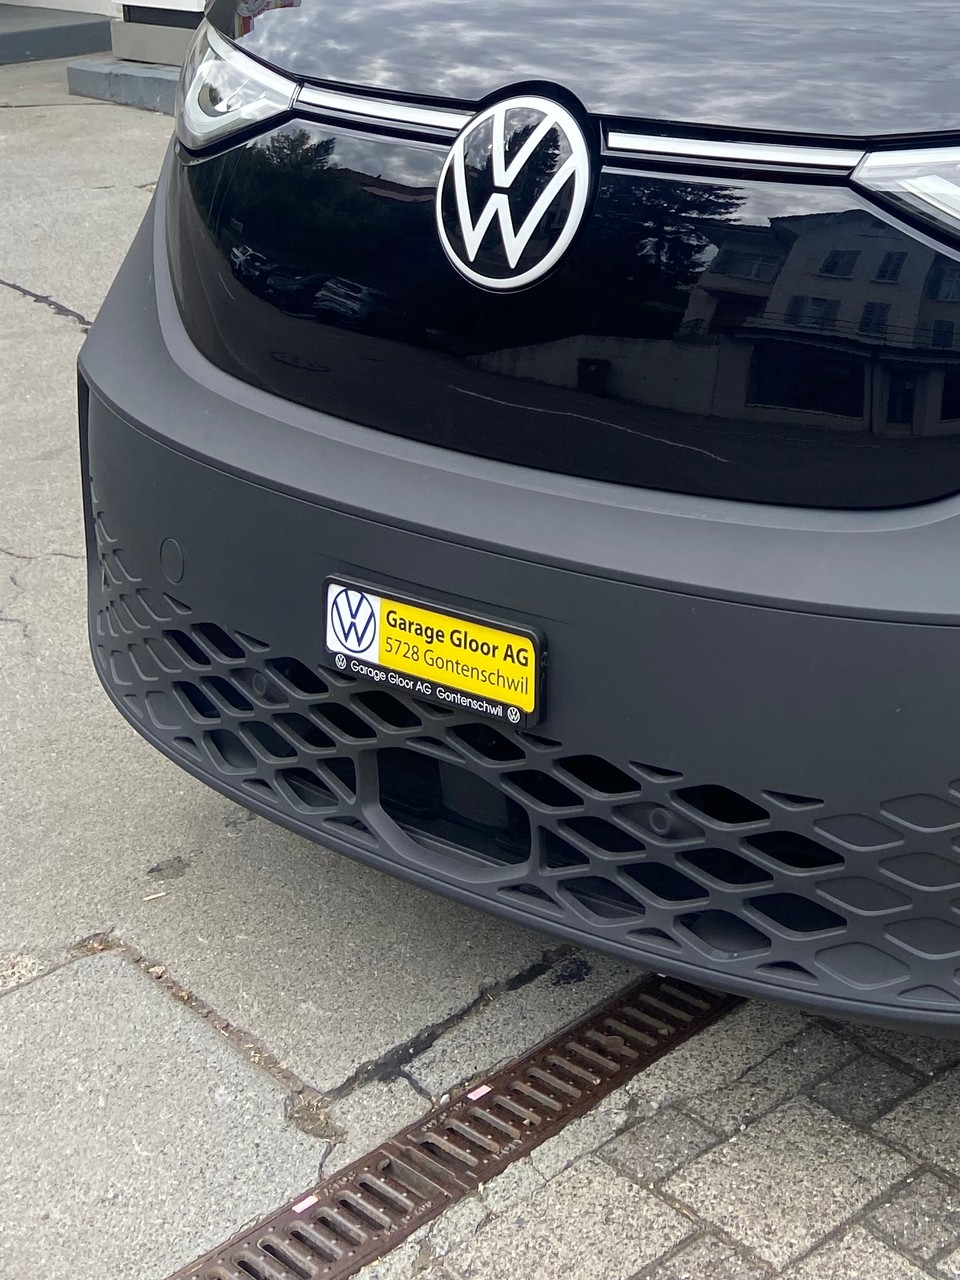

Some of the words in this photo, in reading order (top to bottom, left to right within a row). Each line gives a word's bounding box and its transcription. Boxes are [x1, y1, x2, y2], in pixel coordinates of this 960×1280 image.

[443, 102, 583, 278] VW
[332, 589, 376, 653] VW
[386, 609, 445, 644] Garage
[450, 629, 499, 658] Gloor
[503, 643, 529, 667] AG
[350, 660, 387, 681] Garage
[388, 672, 414, 689] Gloor
[415, 681, 432, 695] AG
[436, 687, 503, 717] Gontenschwil
[385, 636, 420, 662] 5728
[423, 649, 528, 695] Gontenschwil
